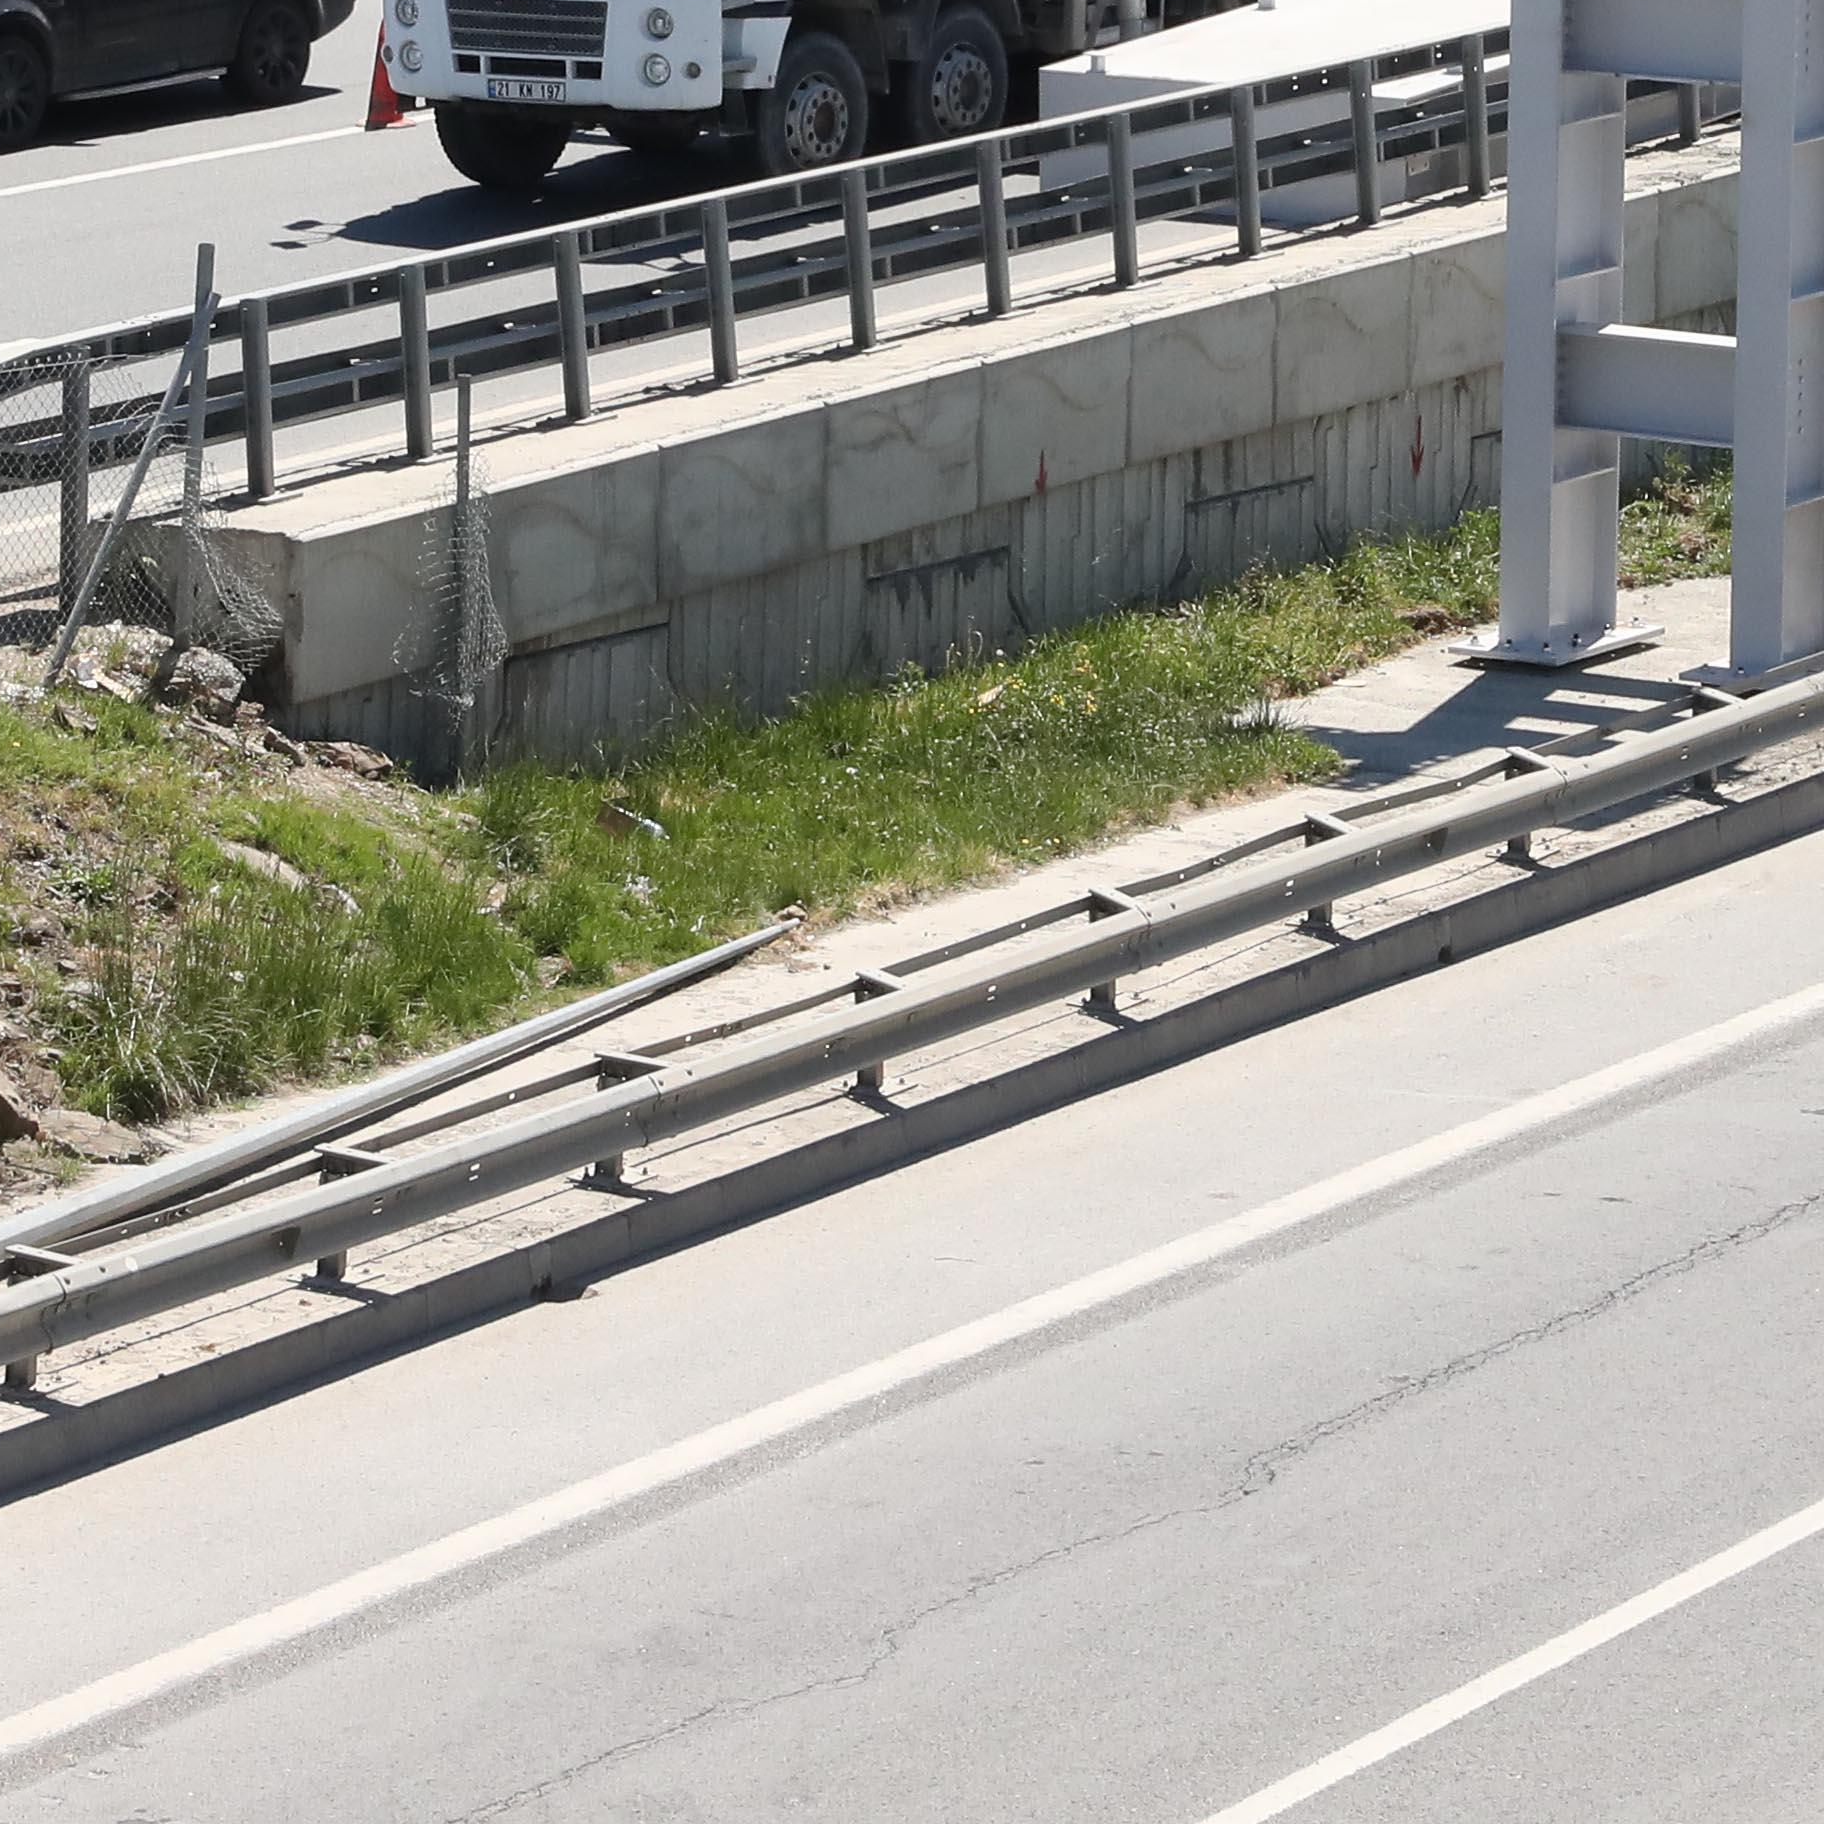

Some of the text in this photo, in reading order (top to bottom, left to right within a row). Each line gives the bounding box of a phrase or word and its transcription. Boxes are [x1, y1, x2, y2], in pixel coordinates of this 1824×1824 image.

[497, 81, 561, 100] 21 KN 197
